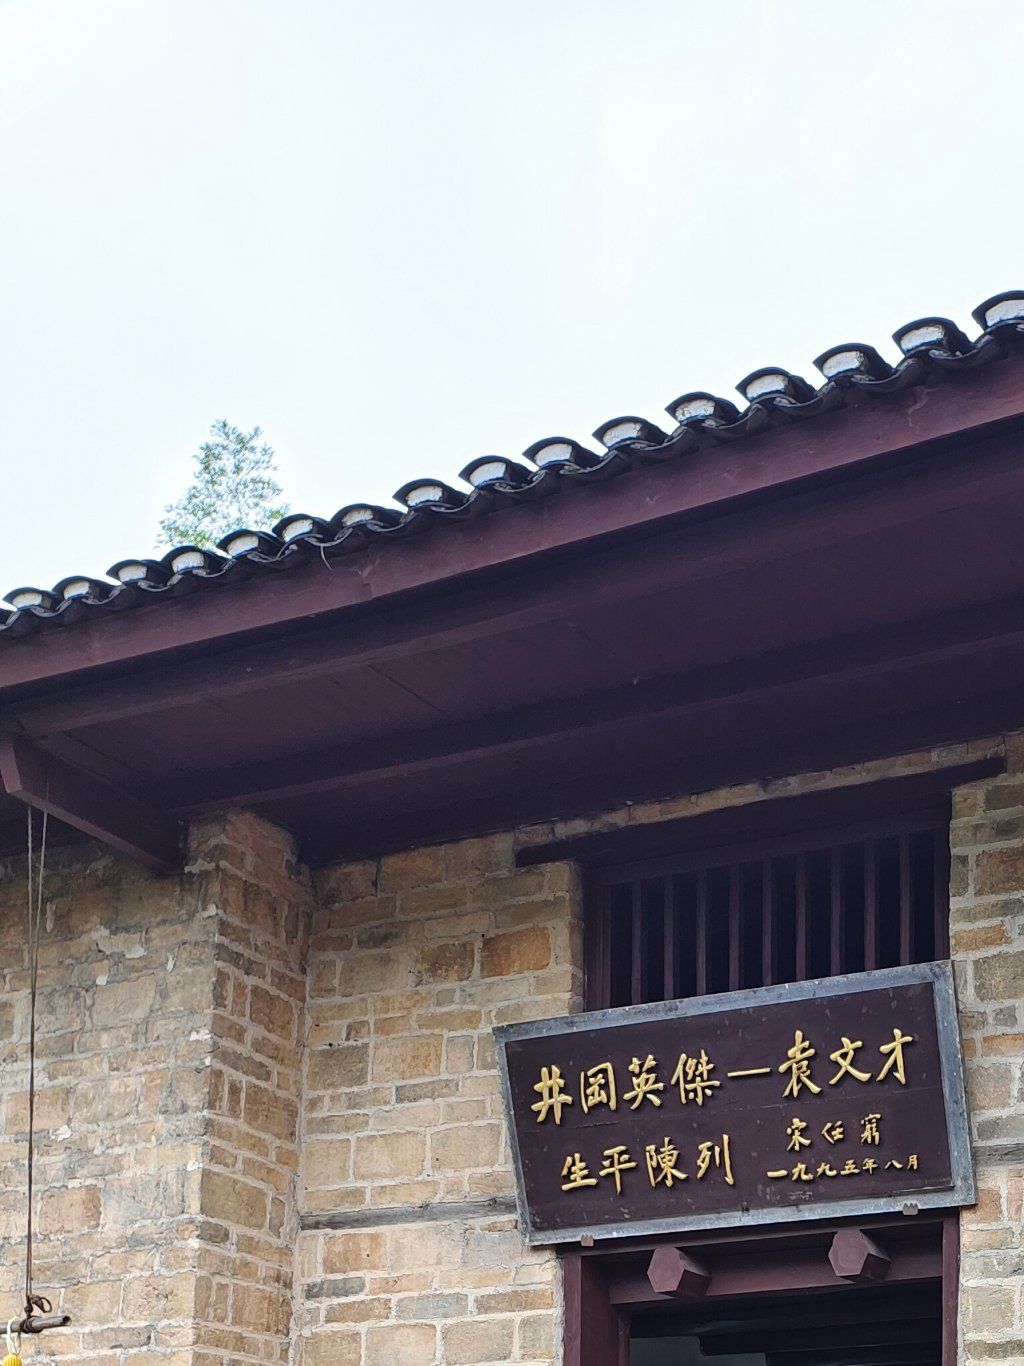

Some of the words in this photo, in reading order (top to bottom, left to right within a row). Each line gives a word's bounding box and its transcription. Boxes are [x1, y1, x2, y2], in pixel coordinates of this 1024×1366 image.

[561, 1134, 734, 1196] 生平陳列
[766, 1154, 919, 1181] 一九九五年八月
